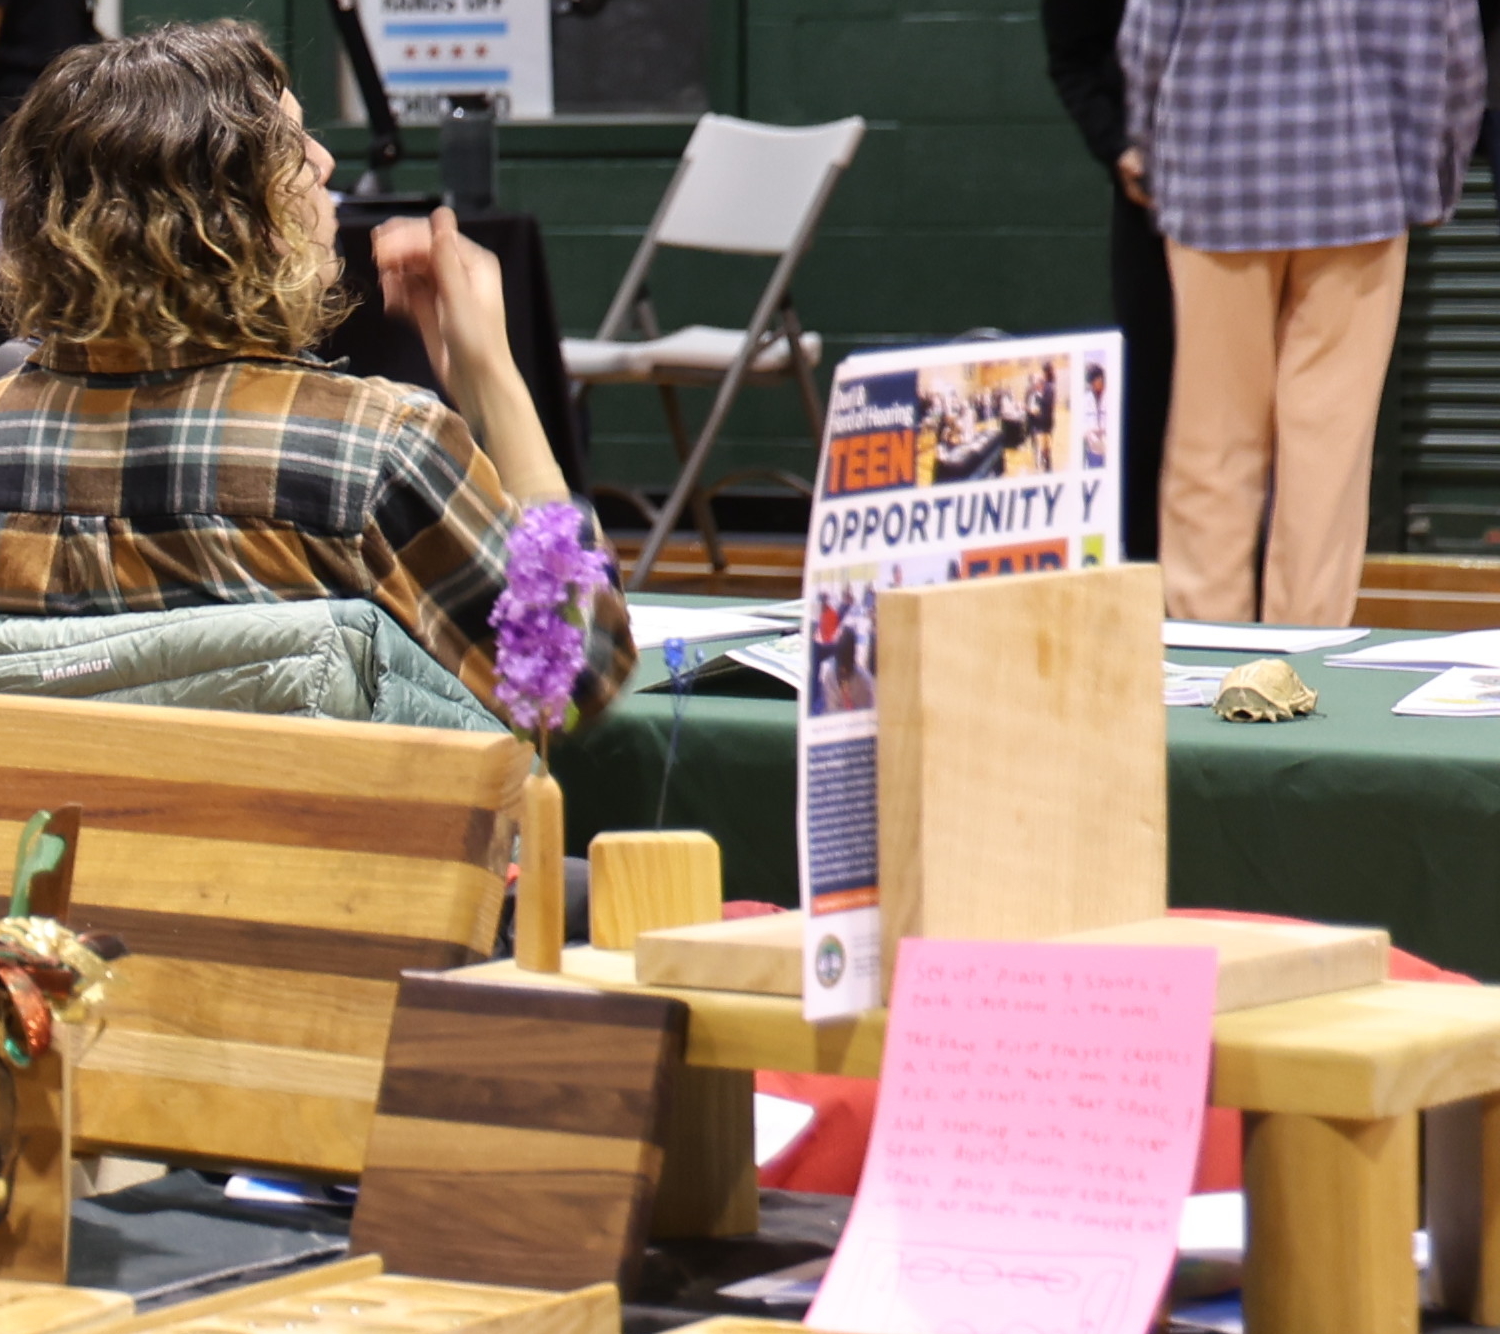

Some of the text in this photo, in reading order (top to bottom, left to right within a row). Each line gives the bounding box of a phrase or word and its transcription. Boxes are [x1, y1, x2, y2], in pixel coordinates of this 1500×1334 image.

[829, 428, 916, 494] TEEN
[818, 482, 1065, 555] OPPORTUNITY
[42, 658, 111, 681] MAMMUT
